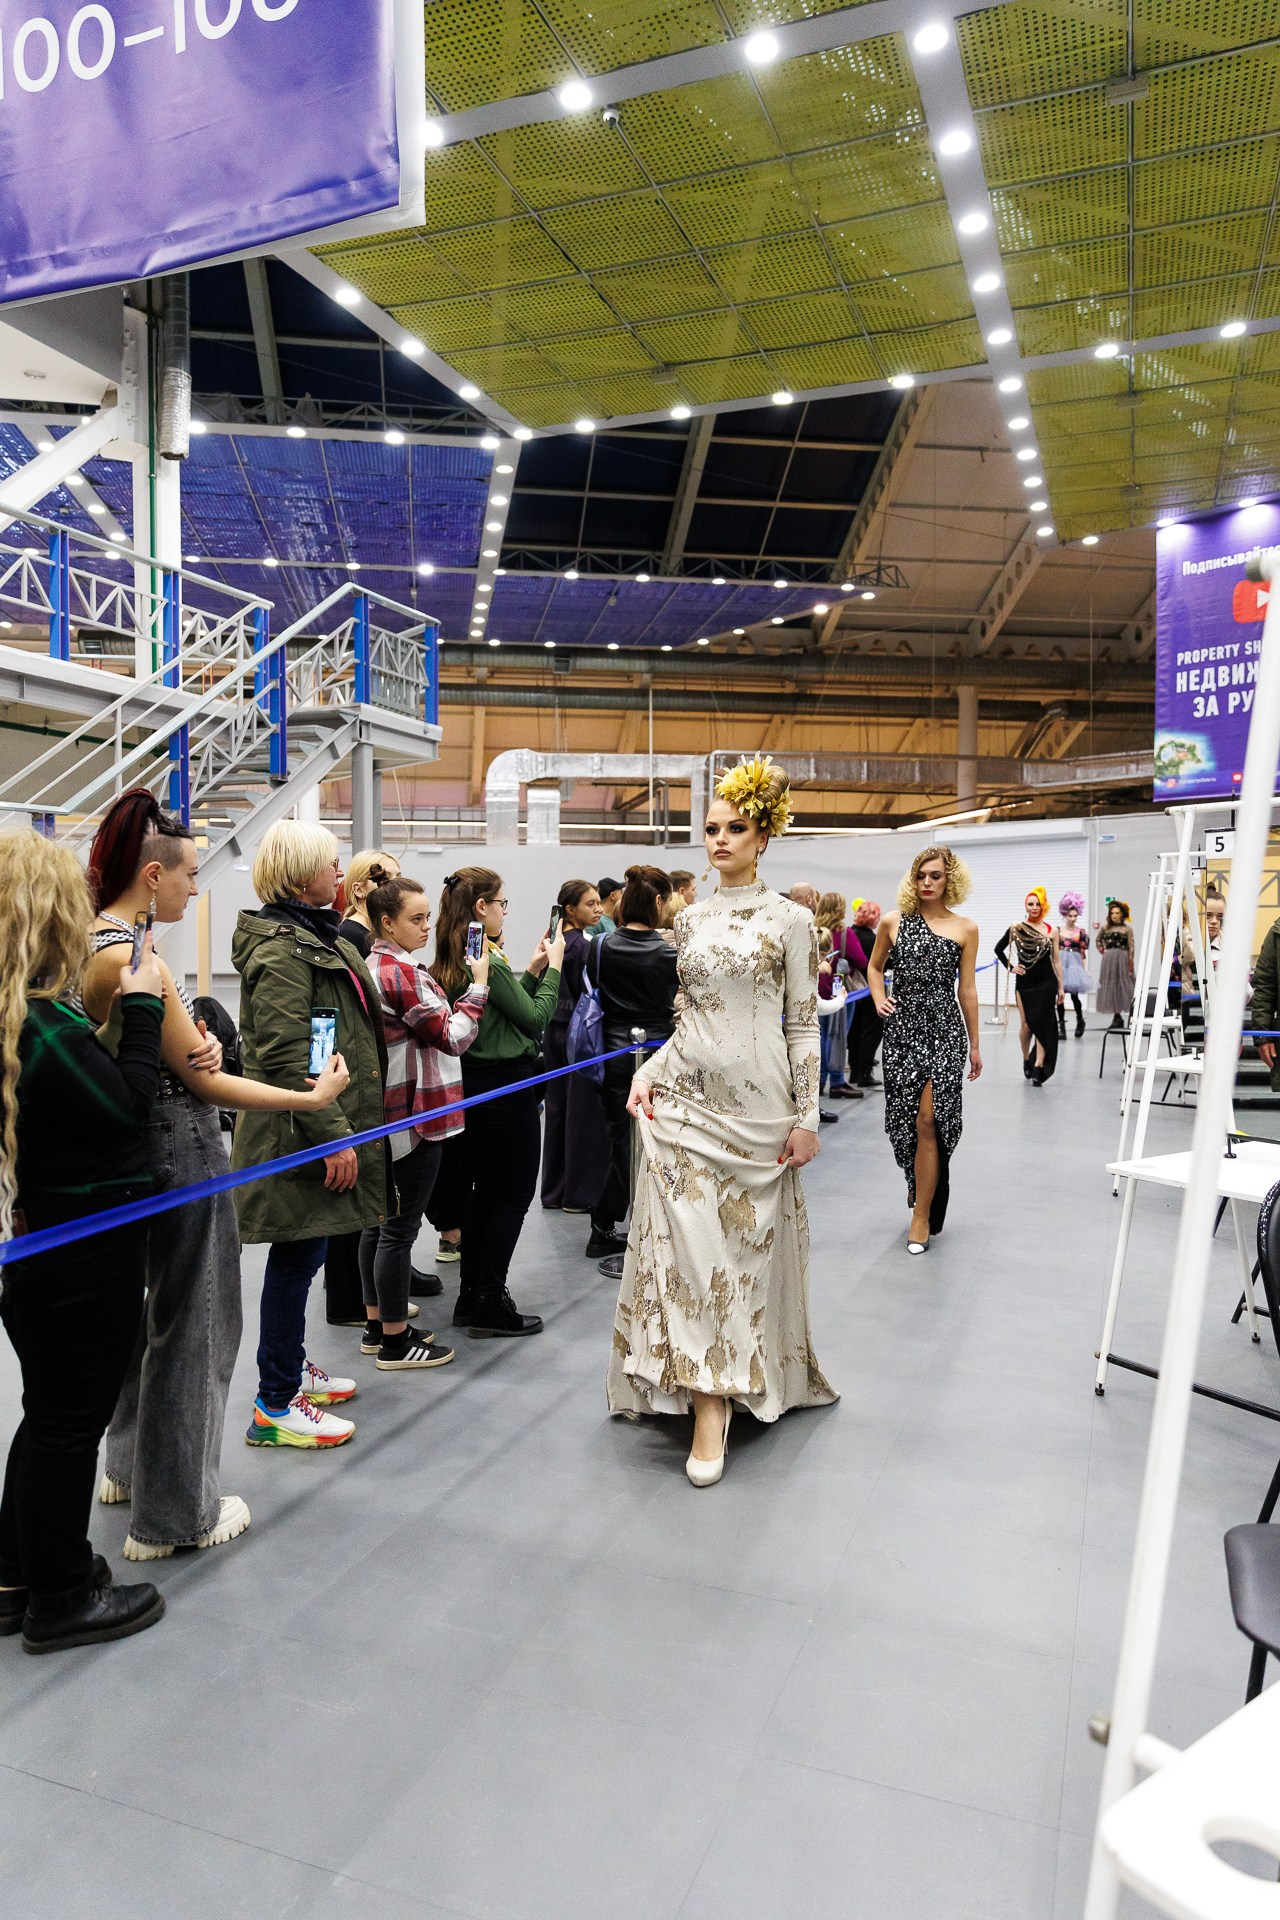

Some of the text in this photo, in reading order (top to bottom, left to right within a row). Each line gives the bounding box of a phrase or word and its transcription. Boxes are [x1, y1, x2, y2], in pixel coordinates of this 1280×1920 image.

[1177, 643, 1240, 667] PROPERTY
[1193, 689, 1255, 718] ЗА РУ
[1214, 836, 1225, 853] 5
